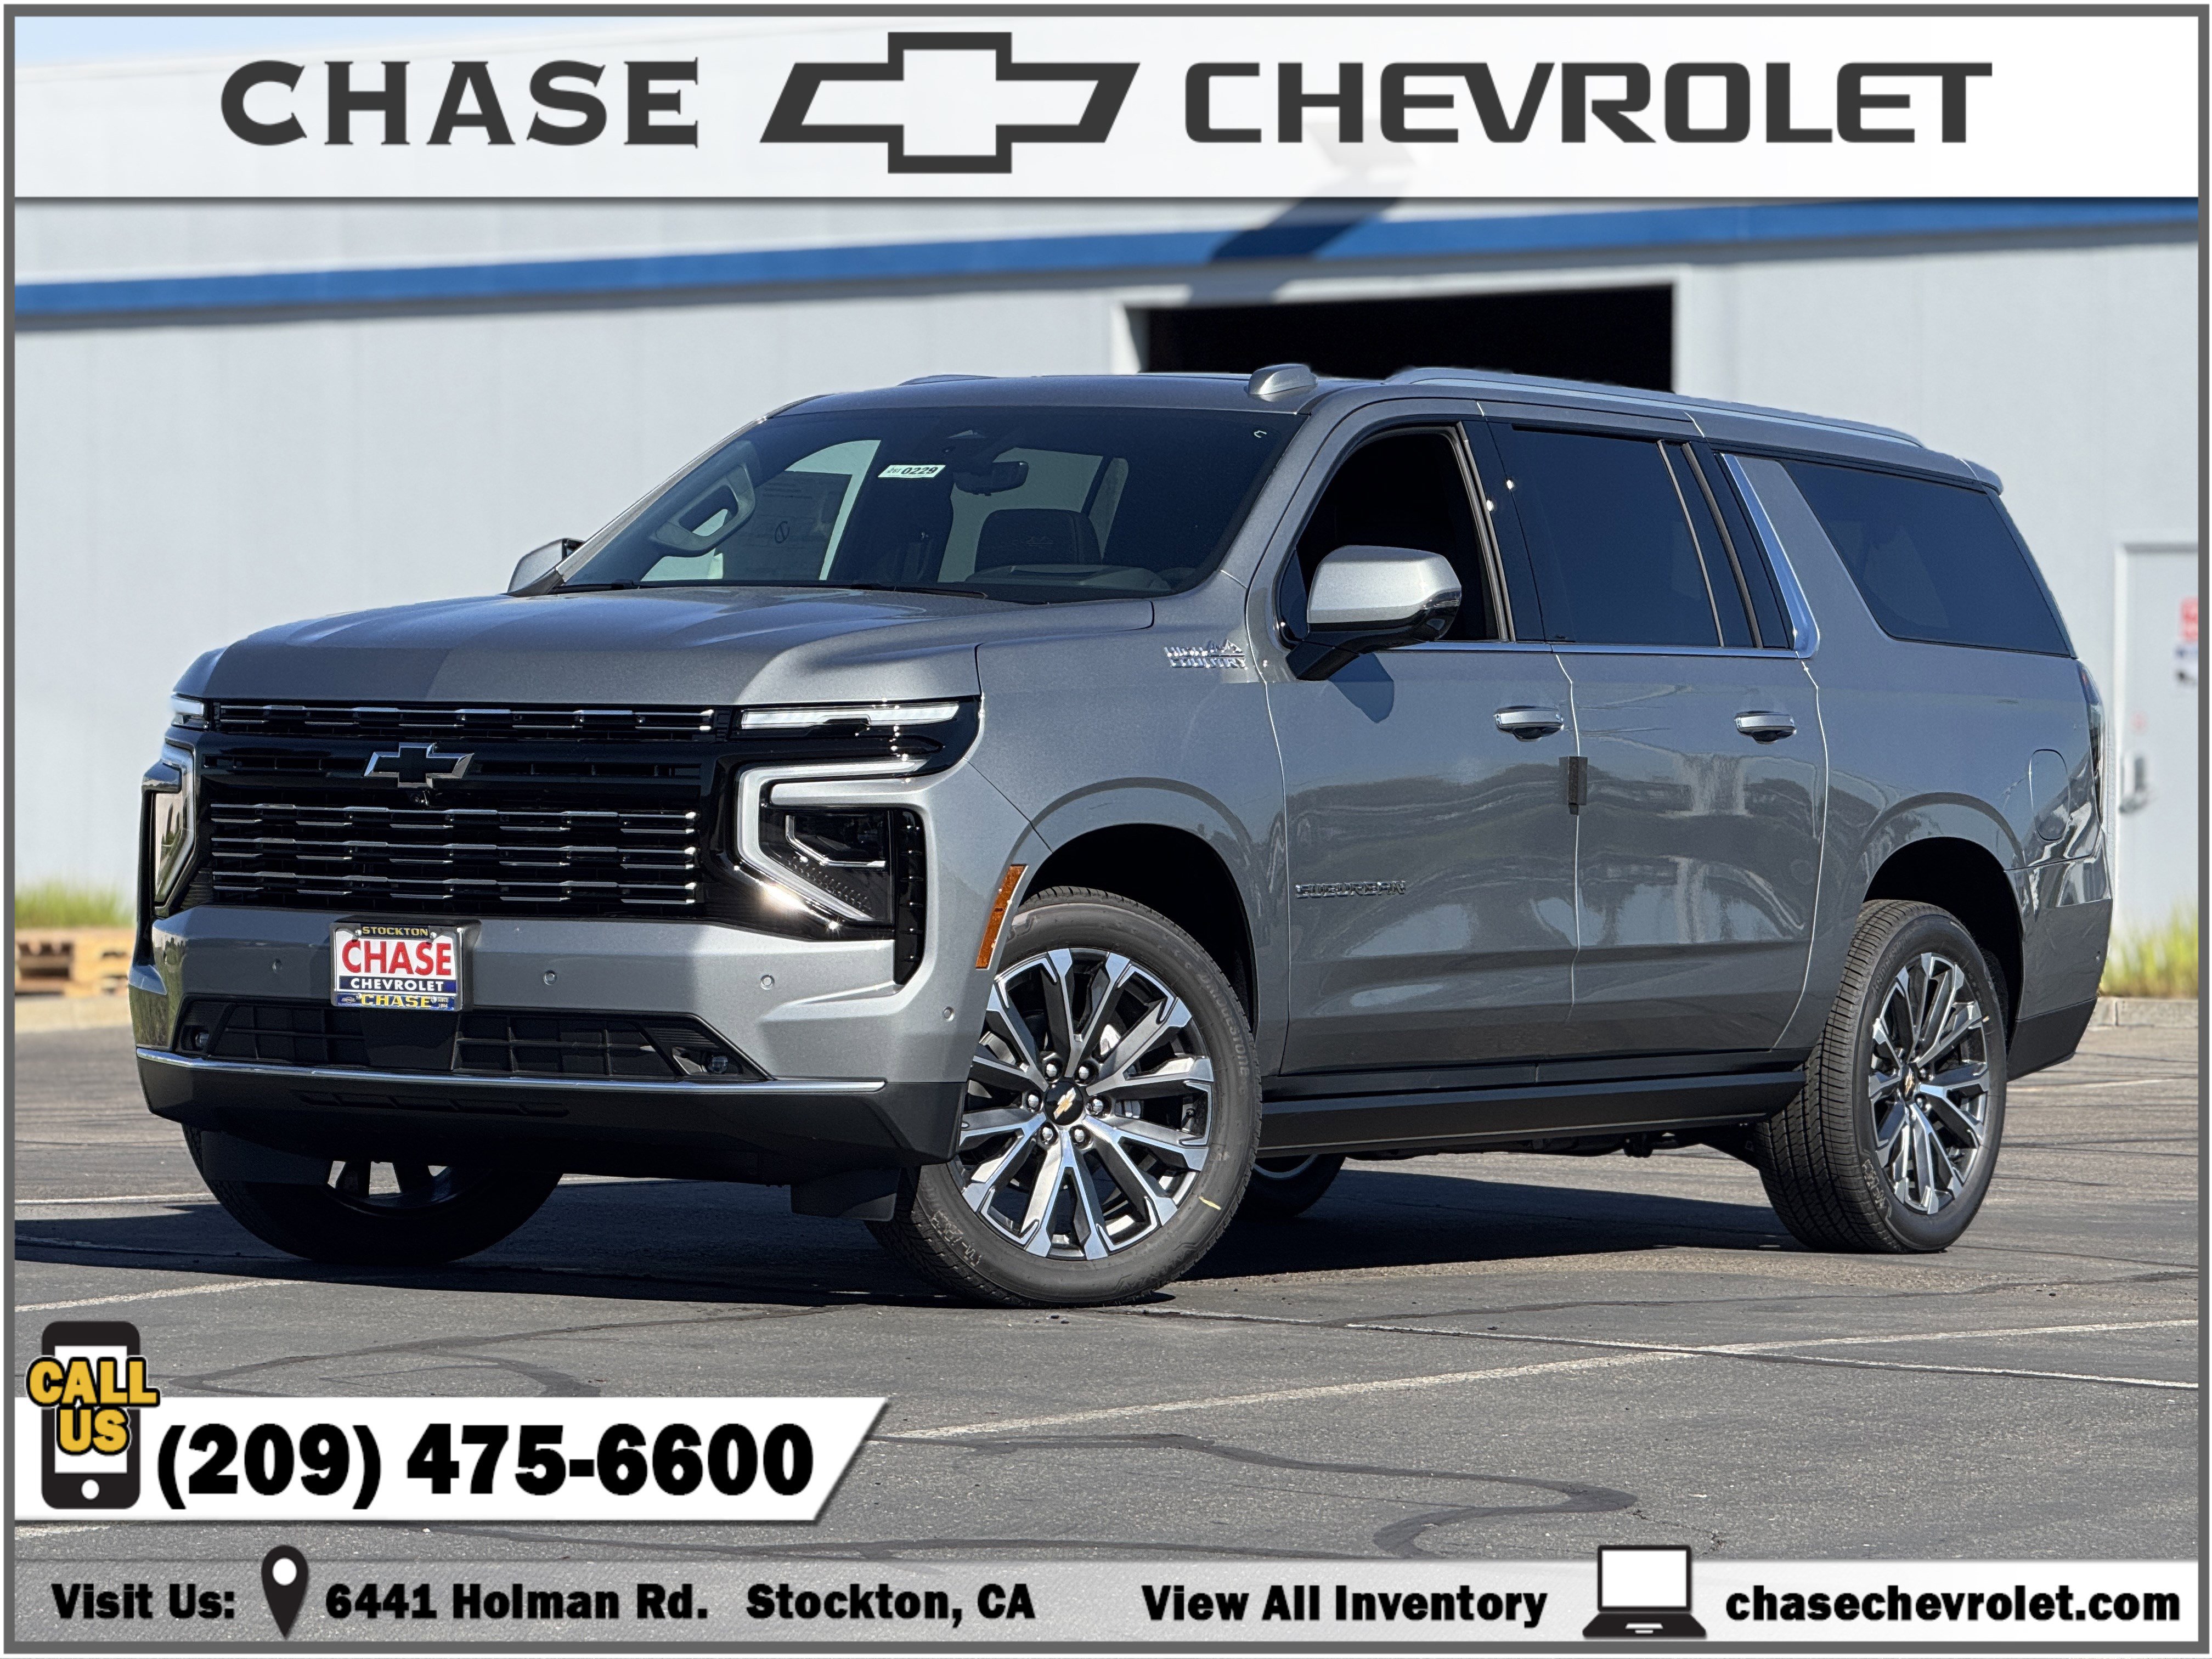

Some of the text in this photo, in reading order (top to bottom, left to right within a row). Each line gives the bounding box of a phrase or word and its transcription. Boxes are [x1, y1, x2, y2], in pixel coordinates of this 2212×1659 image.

[362, 926, 429, 936] STOCKTON
[342, 940, 452, 976] CHASE
[351, 978, 444, 992] CHEVROLET
[360, 994, 432, 1008] CHASE
